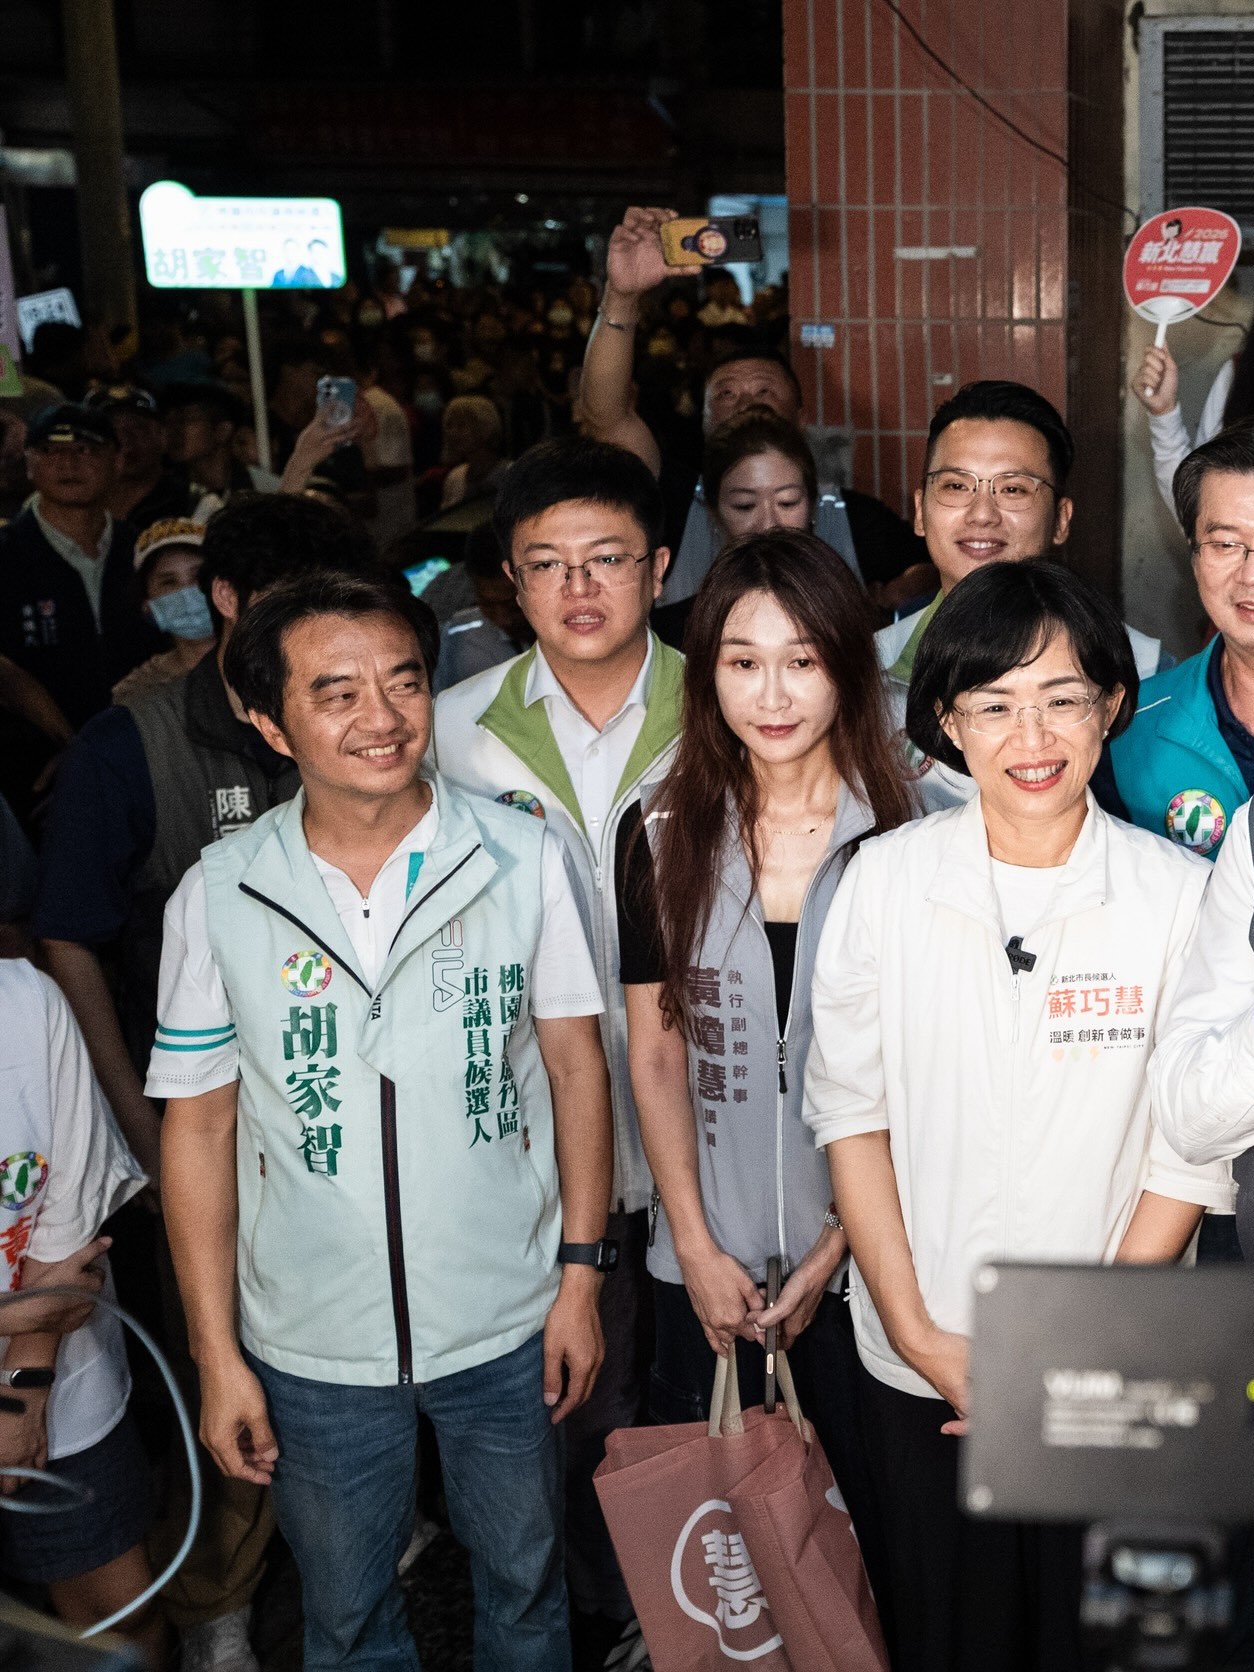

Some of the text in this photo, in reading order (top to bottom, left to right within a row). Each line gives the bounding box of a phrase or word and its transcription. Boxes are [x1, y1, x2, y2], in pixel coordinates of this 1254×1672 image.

[153, 247, 266, 280] 胡家智
[1061, 972, 1117, 984] 新北市長候選人
[1048, 985, 1144, 1019] 蘇巧慧
[727, 970, 749, 1104] 執行副總幹事
[1107, 1027, 1145, 1041] 會做事
[462, 966, 493, 1150] 市議員候選人
[280, 1002, 343, 1177] 胡家智
